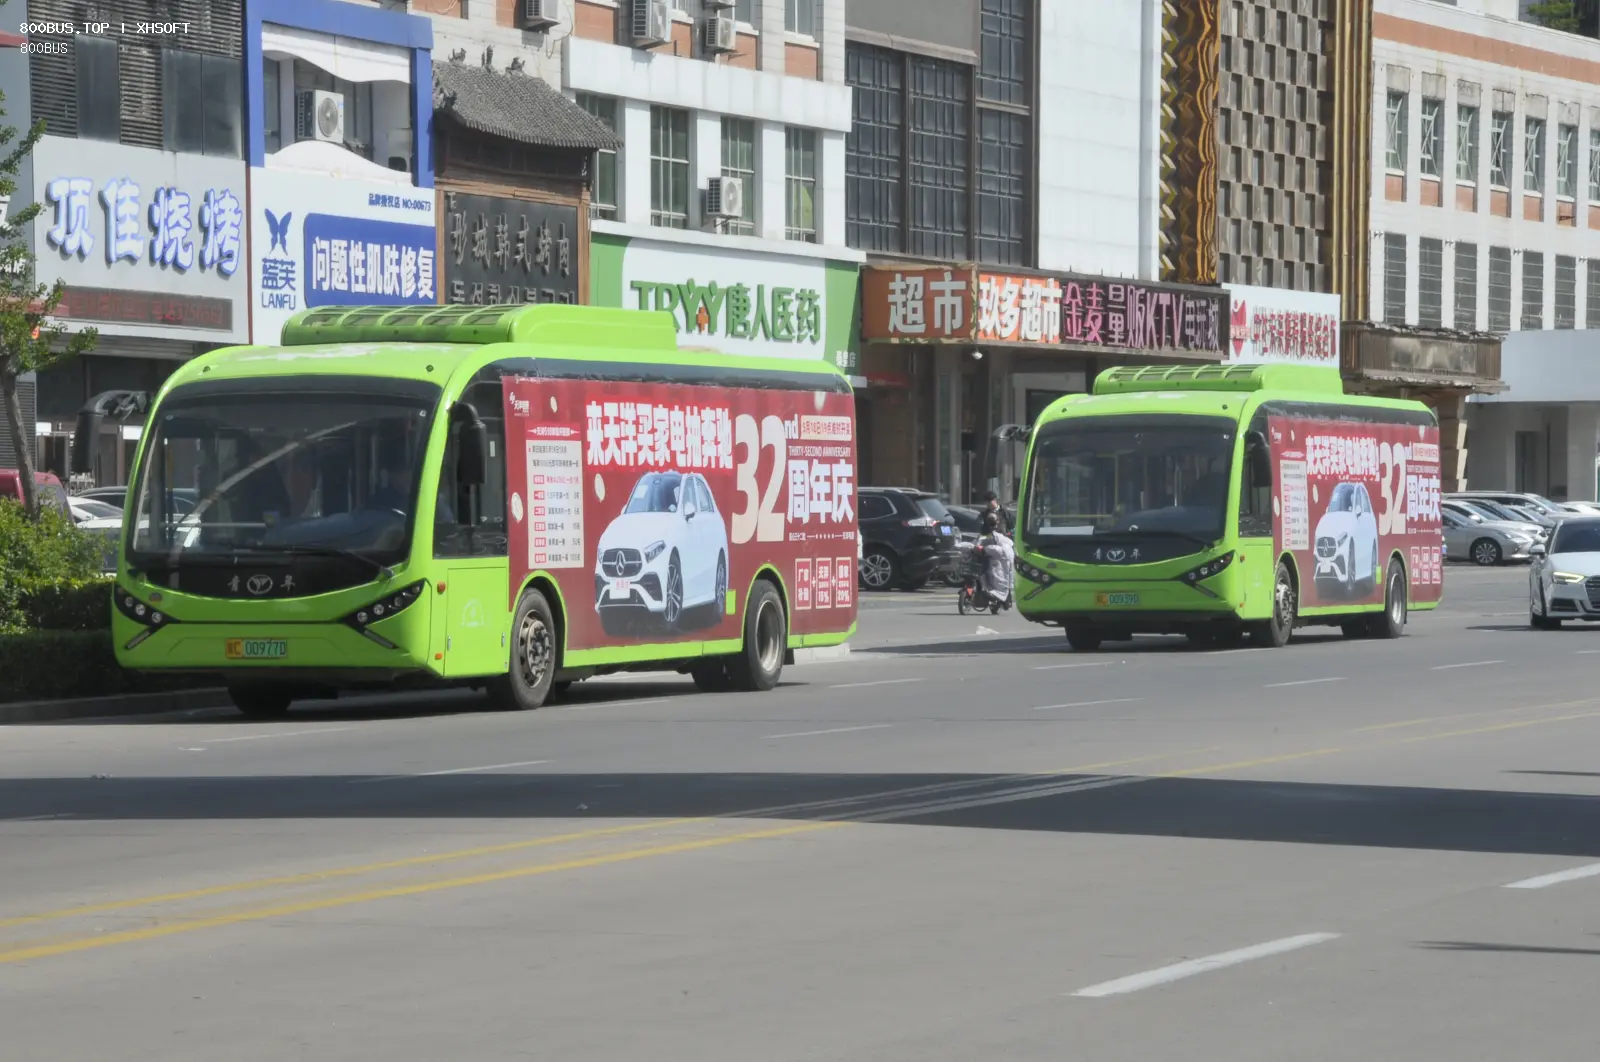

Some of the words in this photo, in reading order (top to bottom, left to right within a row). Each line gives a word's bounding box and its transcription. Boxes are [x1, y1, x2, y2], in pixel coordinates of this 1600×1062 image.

[48, 175, 242, 275] 顶佳烧烤
[312, 235, 434, 300] 问题性肌肤修复
[261, 291, 296, 310] LANFU
[887, 271, 967, 335] 超市
[978, 275, 1063, 342] 玖多超市
[787, 459, 854, 524] 周年庆
